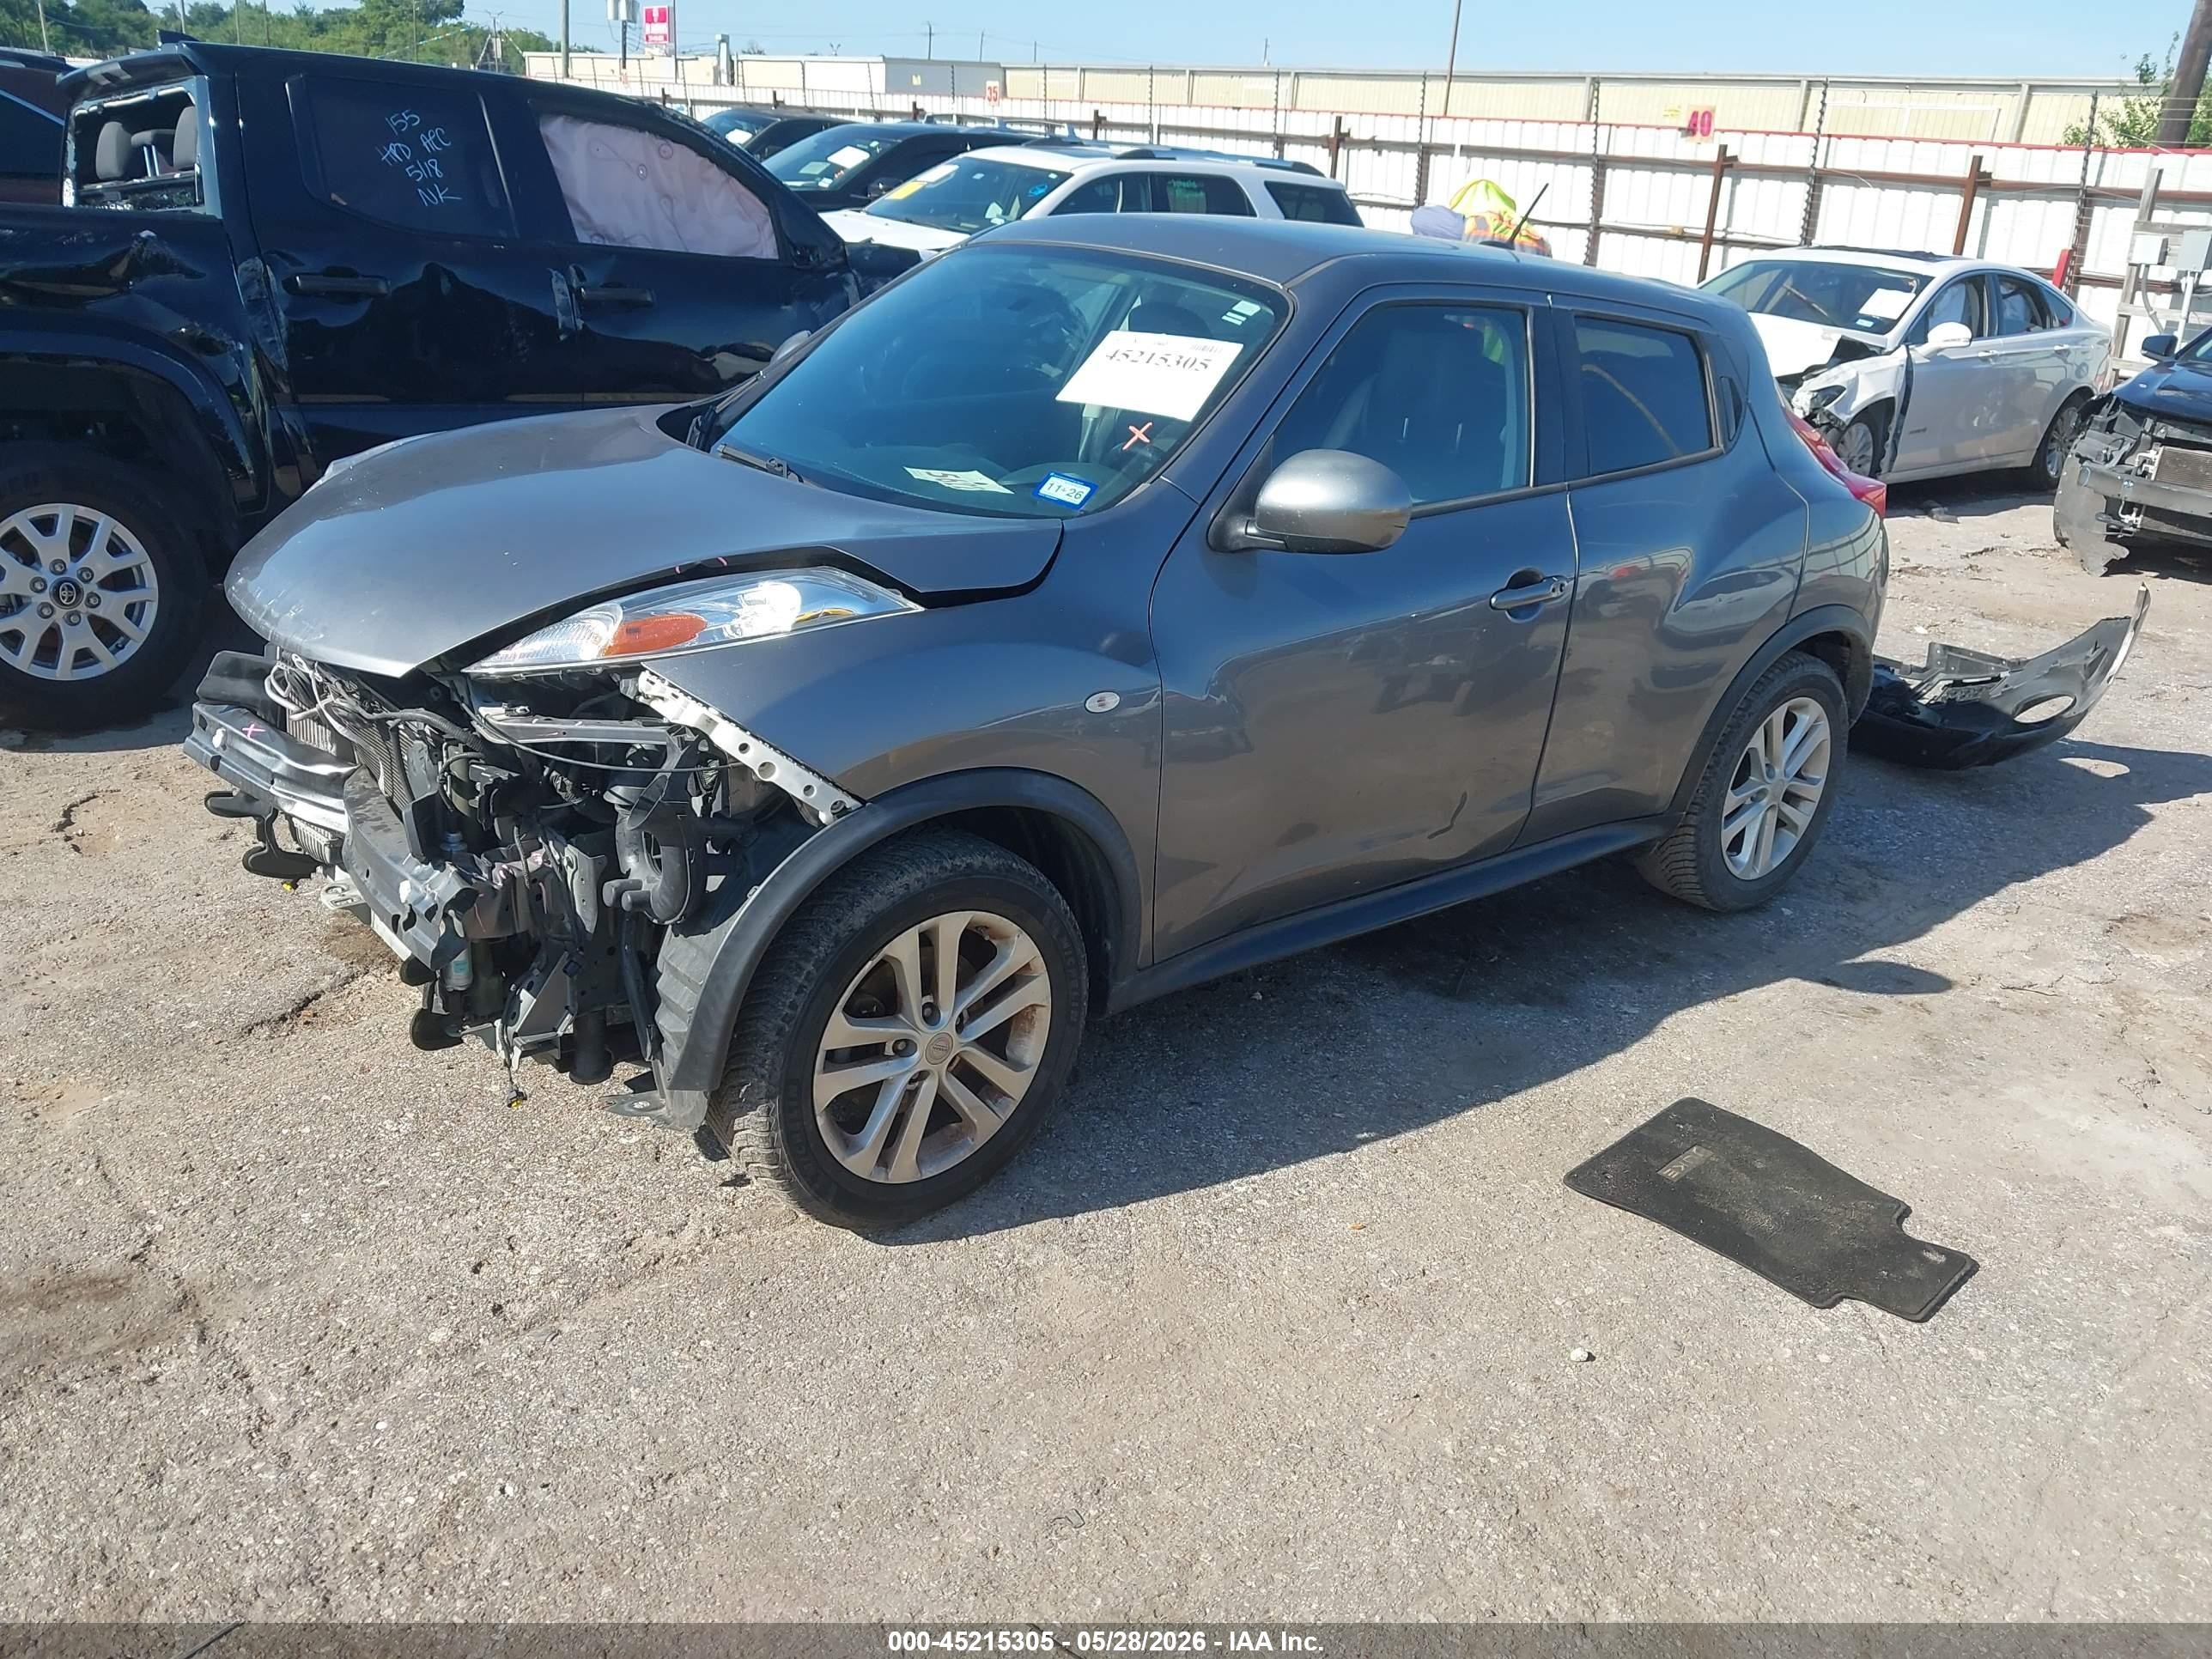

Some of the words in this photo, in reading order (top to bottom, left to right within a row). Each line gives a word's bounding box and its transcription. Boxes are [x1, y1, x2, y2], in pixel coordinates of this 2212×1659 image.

[988, 86, 998, 102] 35
[385, 109, 421, 136] 155
[1687, 110, 1712, 137] 40
[1105, 349, 1212, 372] 45215305
